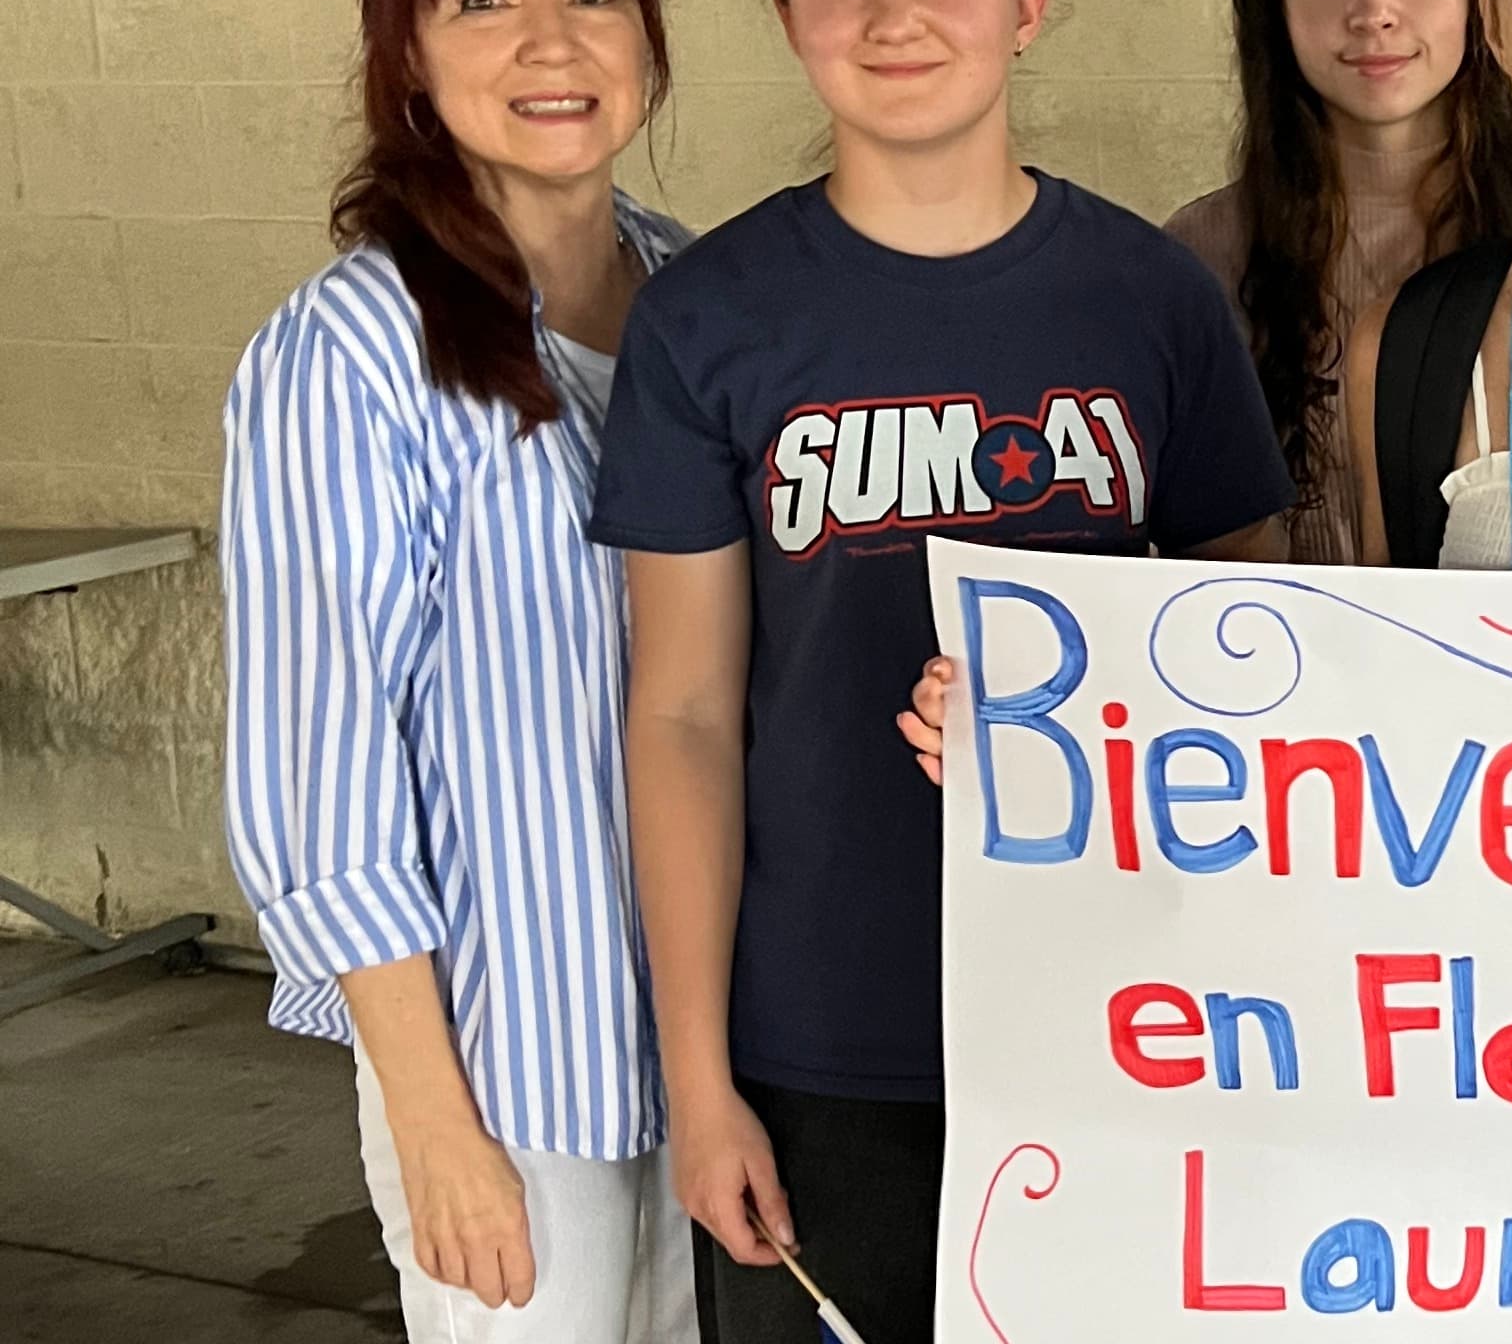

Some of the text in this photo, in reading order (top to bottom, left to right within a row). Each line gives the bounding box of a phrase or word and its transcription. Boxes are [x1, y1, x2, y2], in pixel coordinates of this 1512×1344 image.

[771, 397, 1146, 552] SUM 41
[1108, 983, 1299, 1090] en
